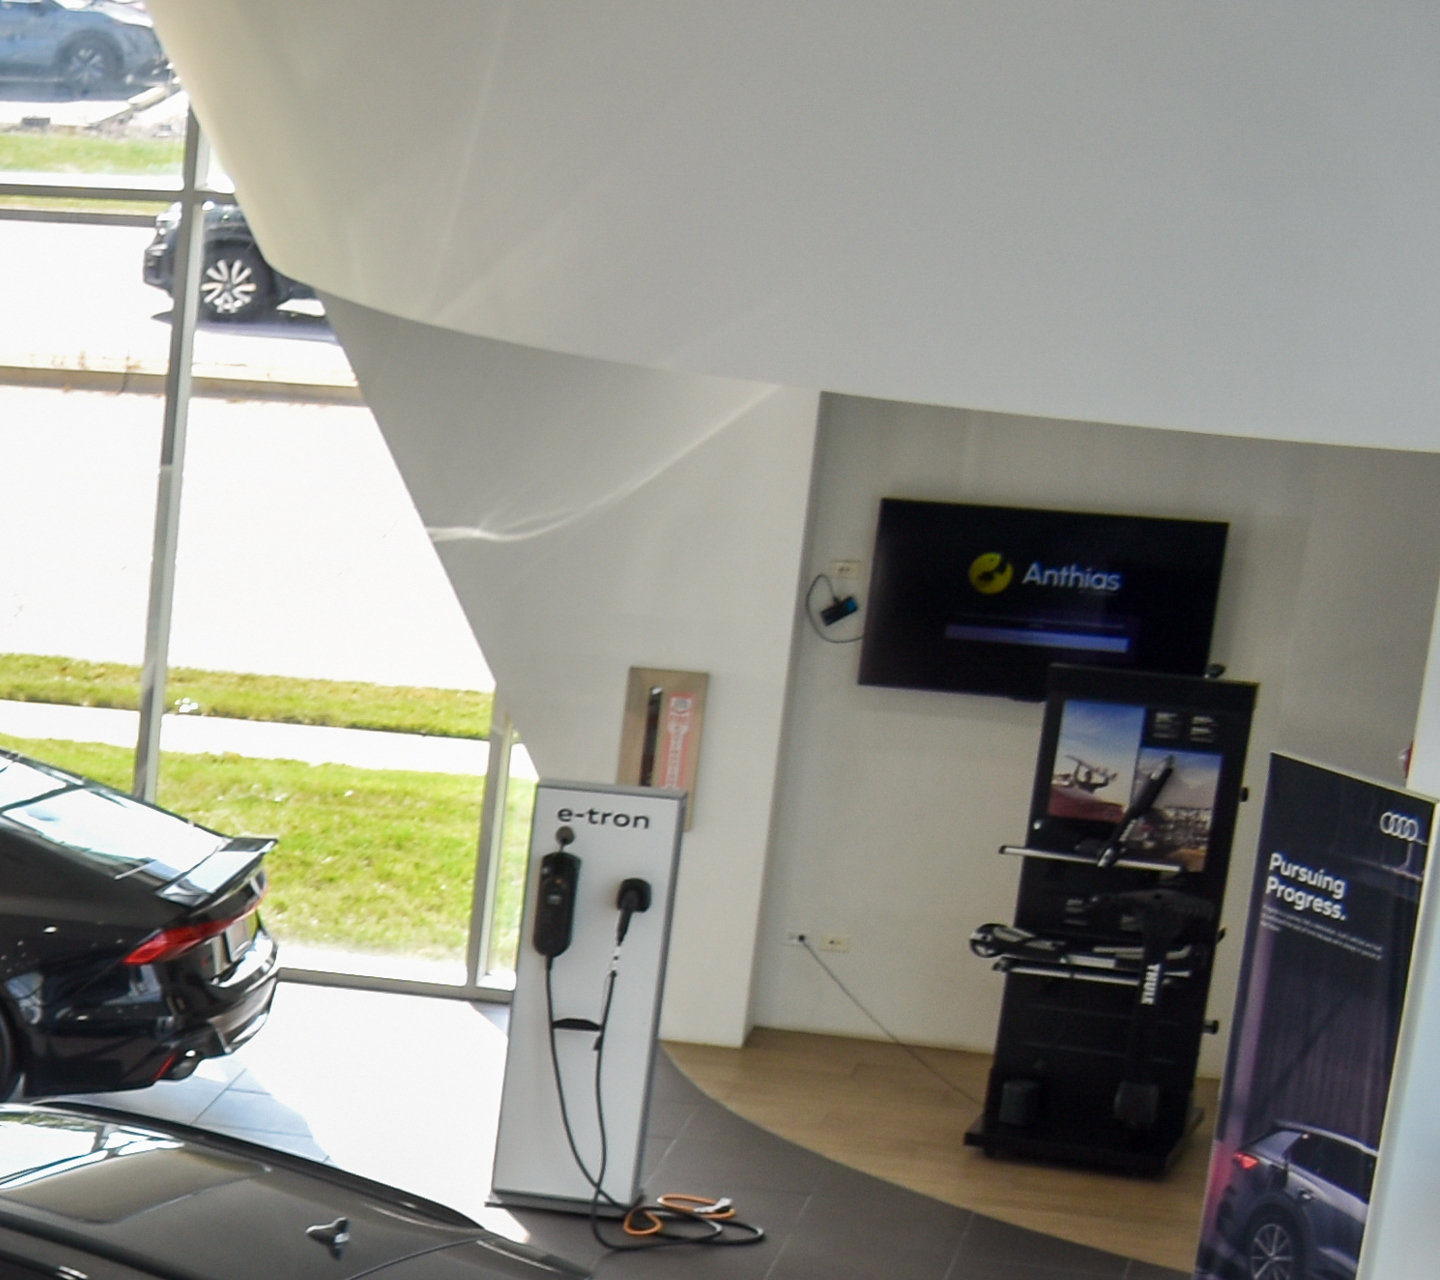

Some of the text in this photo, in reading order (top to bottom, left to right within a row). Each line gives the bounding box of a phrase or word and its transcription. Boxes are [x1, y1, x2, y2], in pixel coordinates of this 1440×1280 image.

[1022, 562, 1121, 591] Anthias
[557, 808, 650, 829] e-tron
[1269, 852, 1346, 899] Pursuing
[1265, 876, 1347, 921] Progress.
[1141, 963, 1161, 1005] THULE
